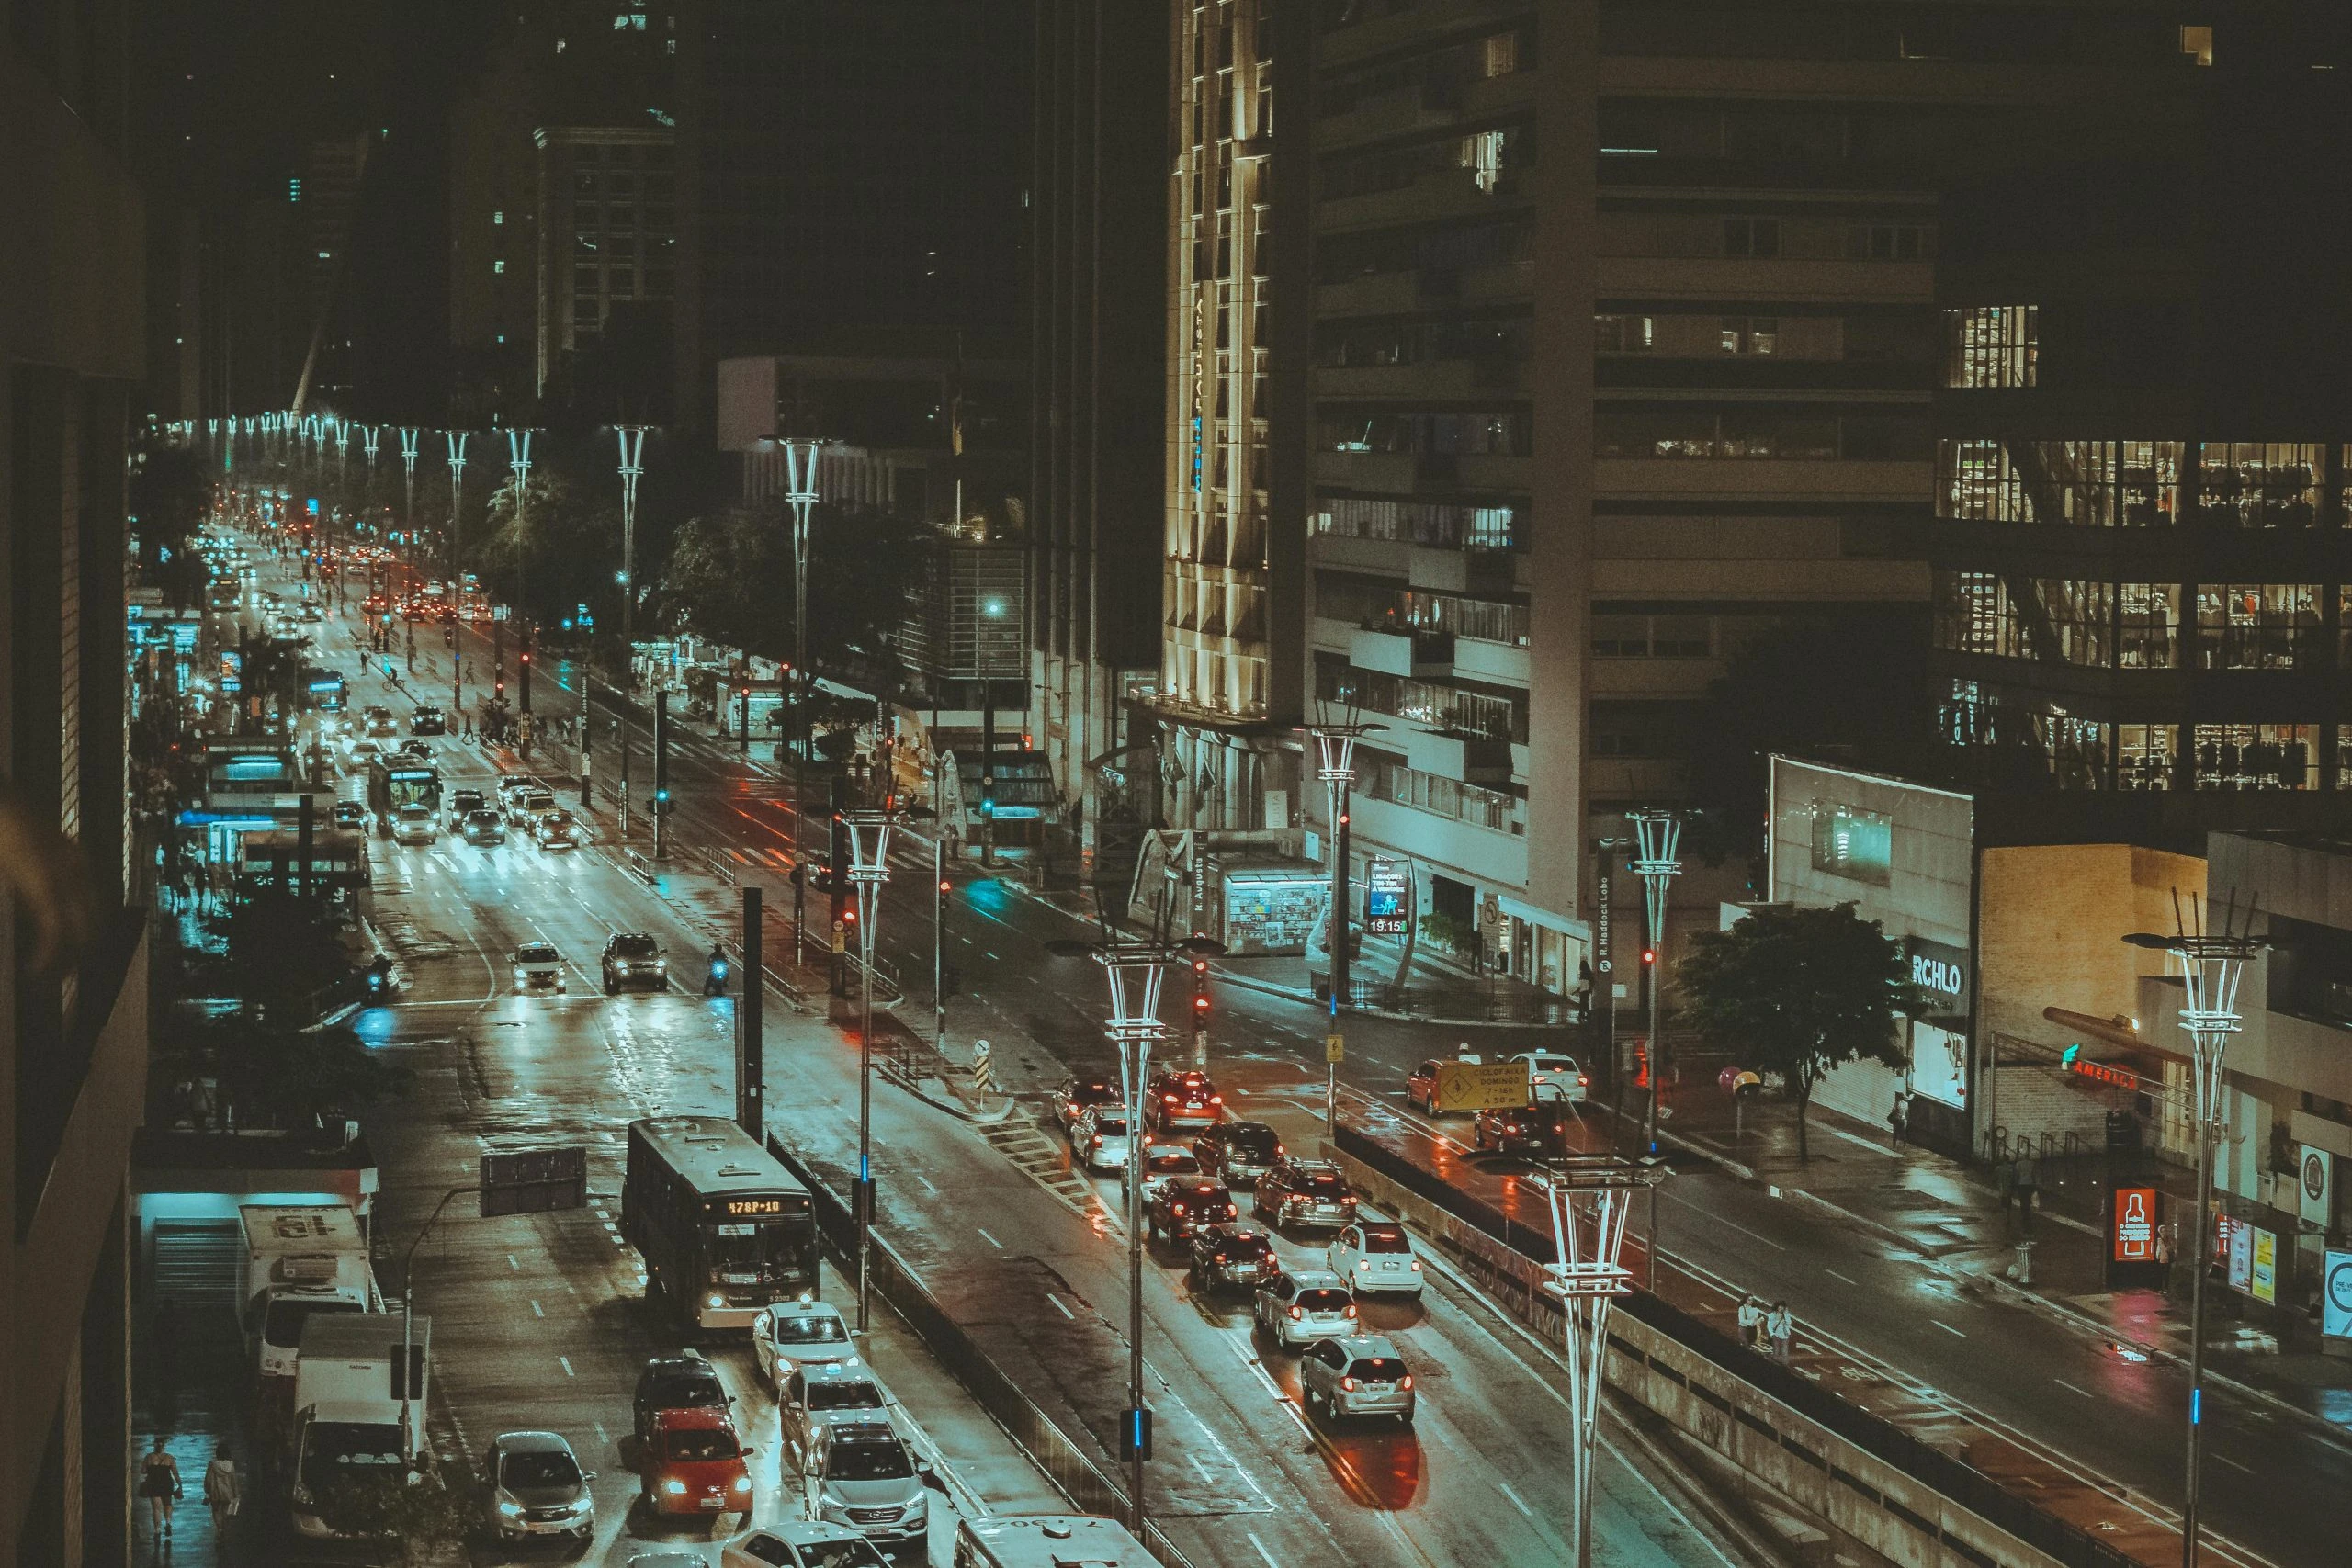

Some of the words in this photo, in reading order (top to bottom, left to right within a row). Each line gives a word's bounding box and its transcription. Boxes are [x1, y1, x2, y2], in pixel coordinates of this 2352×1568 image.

[1194, 857, 1205, 899] Augusta
[1599, 876, 1608, 901] Lobo
[1370, 919, 1401, 931] 19:15
[1599, 903, 1608, 945] Haddock
[1599, 947, 1608, 956] R.
[1912, 955, 1961, 995] RCHLO
[1473, 1067, 1526, 1077] CICLOFAIXA
[1480, 1077, 1520, 1085] DOMINGO
[728, 1201, 780, 1213] 478P-10
